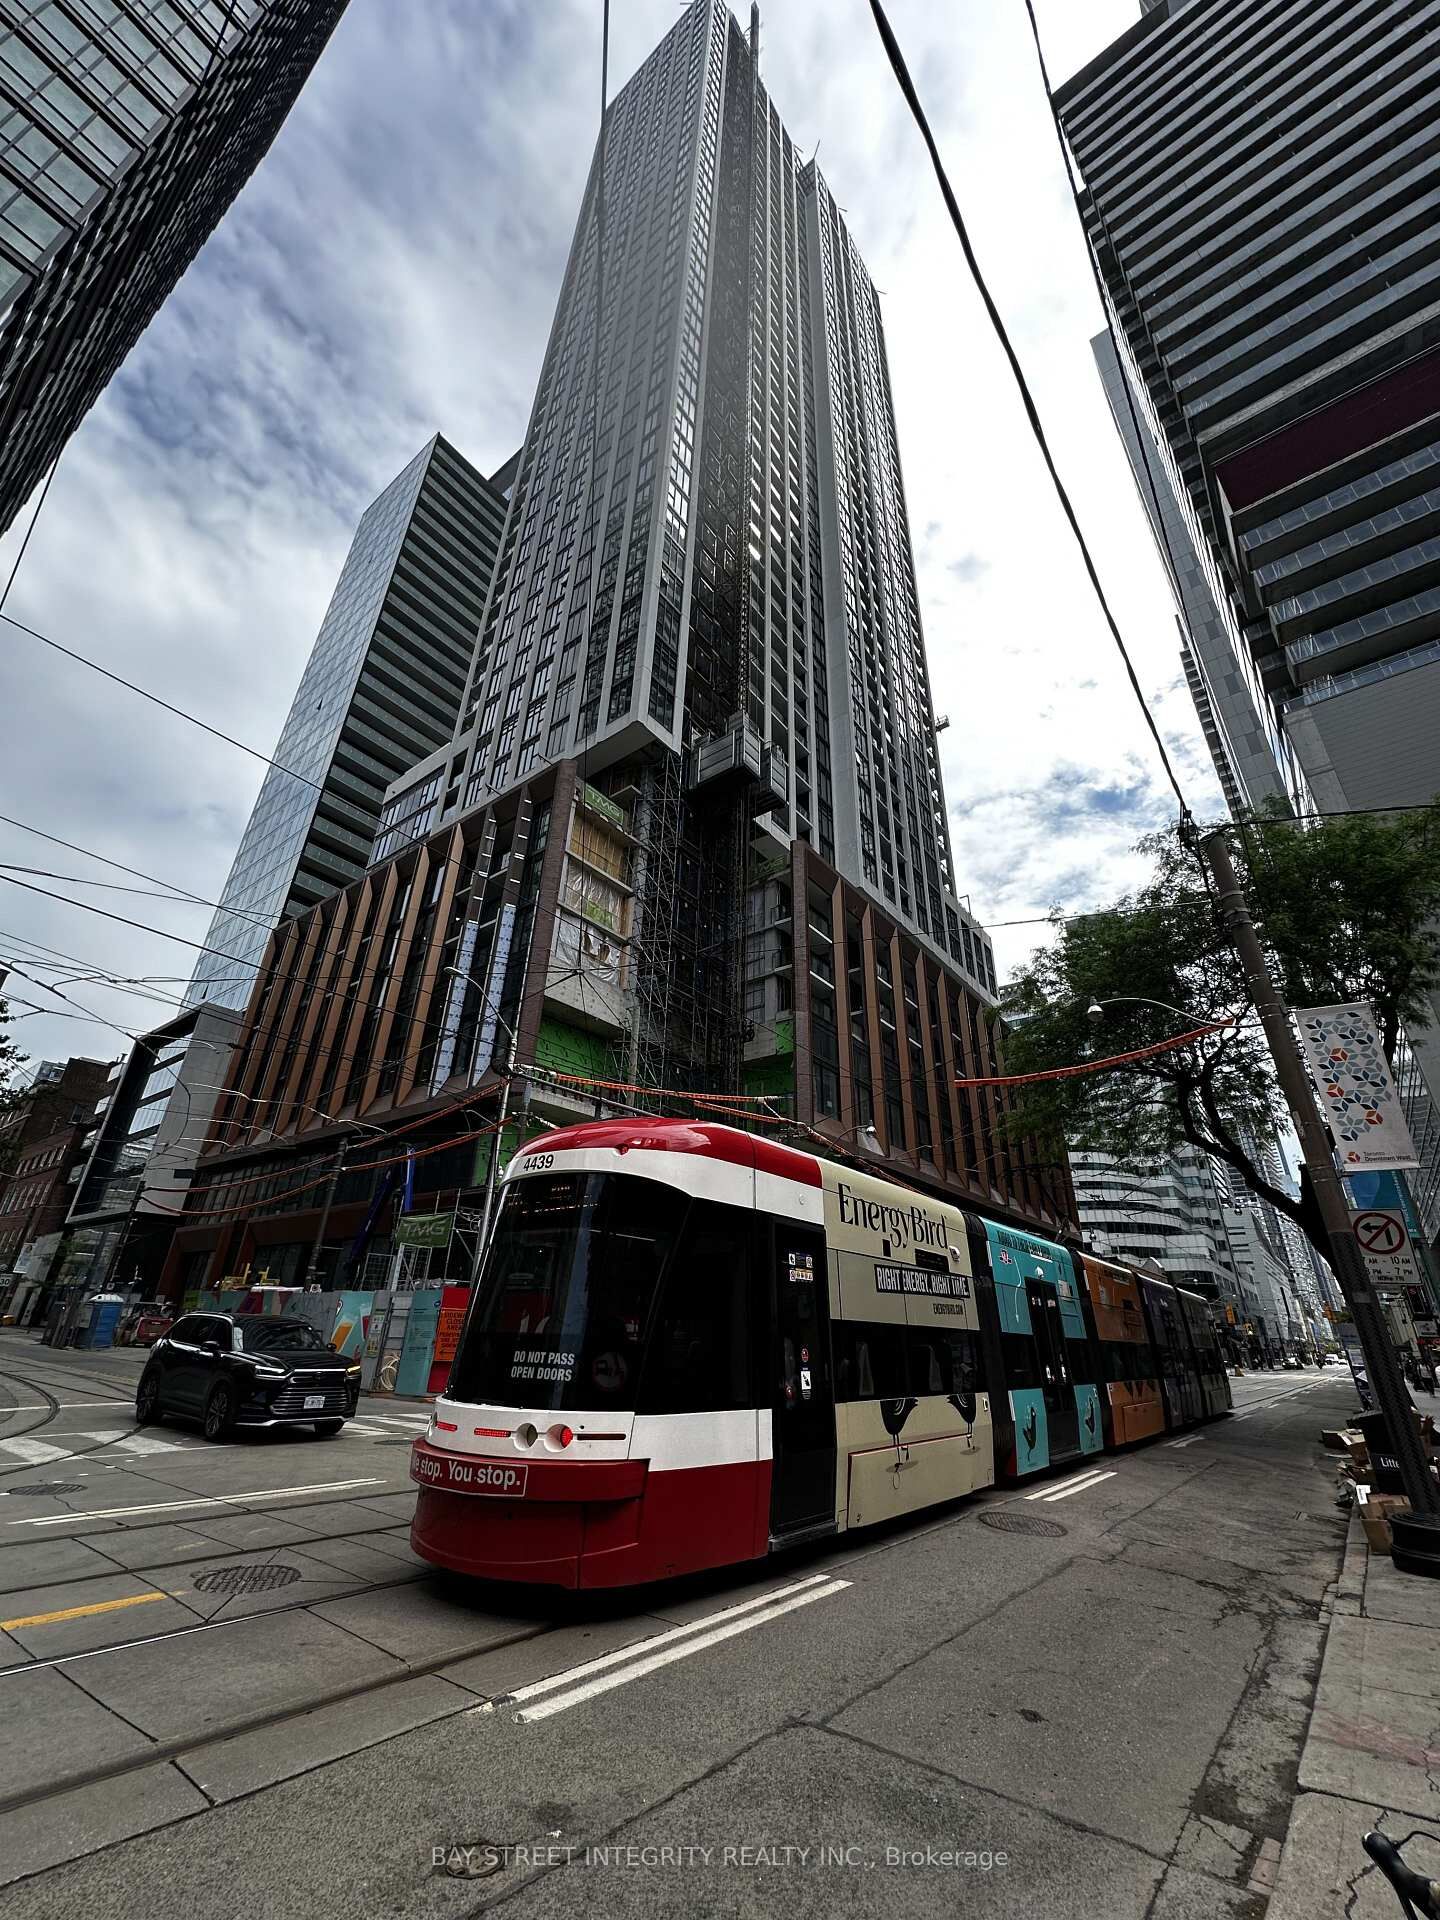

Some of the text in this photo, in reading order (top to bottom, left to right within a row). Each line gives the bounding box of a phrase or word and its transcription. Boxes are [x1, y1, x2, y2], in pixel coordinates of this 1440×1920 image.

[587, 788, 620, 817] TMG
[523, 1155, 553, 1171] 4439
[837, 1182, 947, 1249] EnergyBird
[400, 1220, 449, 1238] TMG
[1390, 1256, 1400, 1265] 10
[1394, 1267, 1400, 1275] 7
[876, 1267, 901, 1290] RIGHT
[931, 1274, 950, 1295] RIGHT
[513, 1351, 575, 1366] DO NOT PASS
[511, 1366, 572, 1381] OPEN DOORS
[421, 1457, 443, 1482] stop.
[448, 1460, 472, 1483] You
[477, 1465, 520, 1491] stop.
